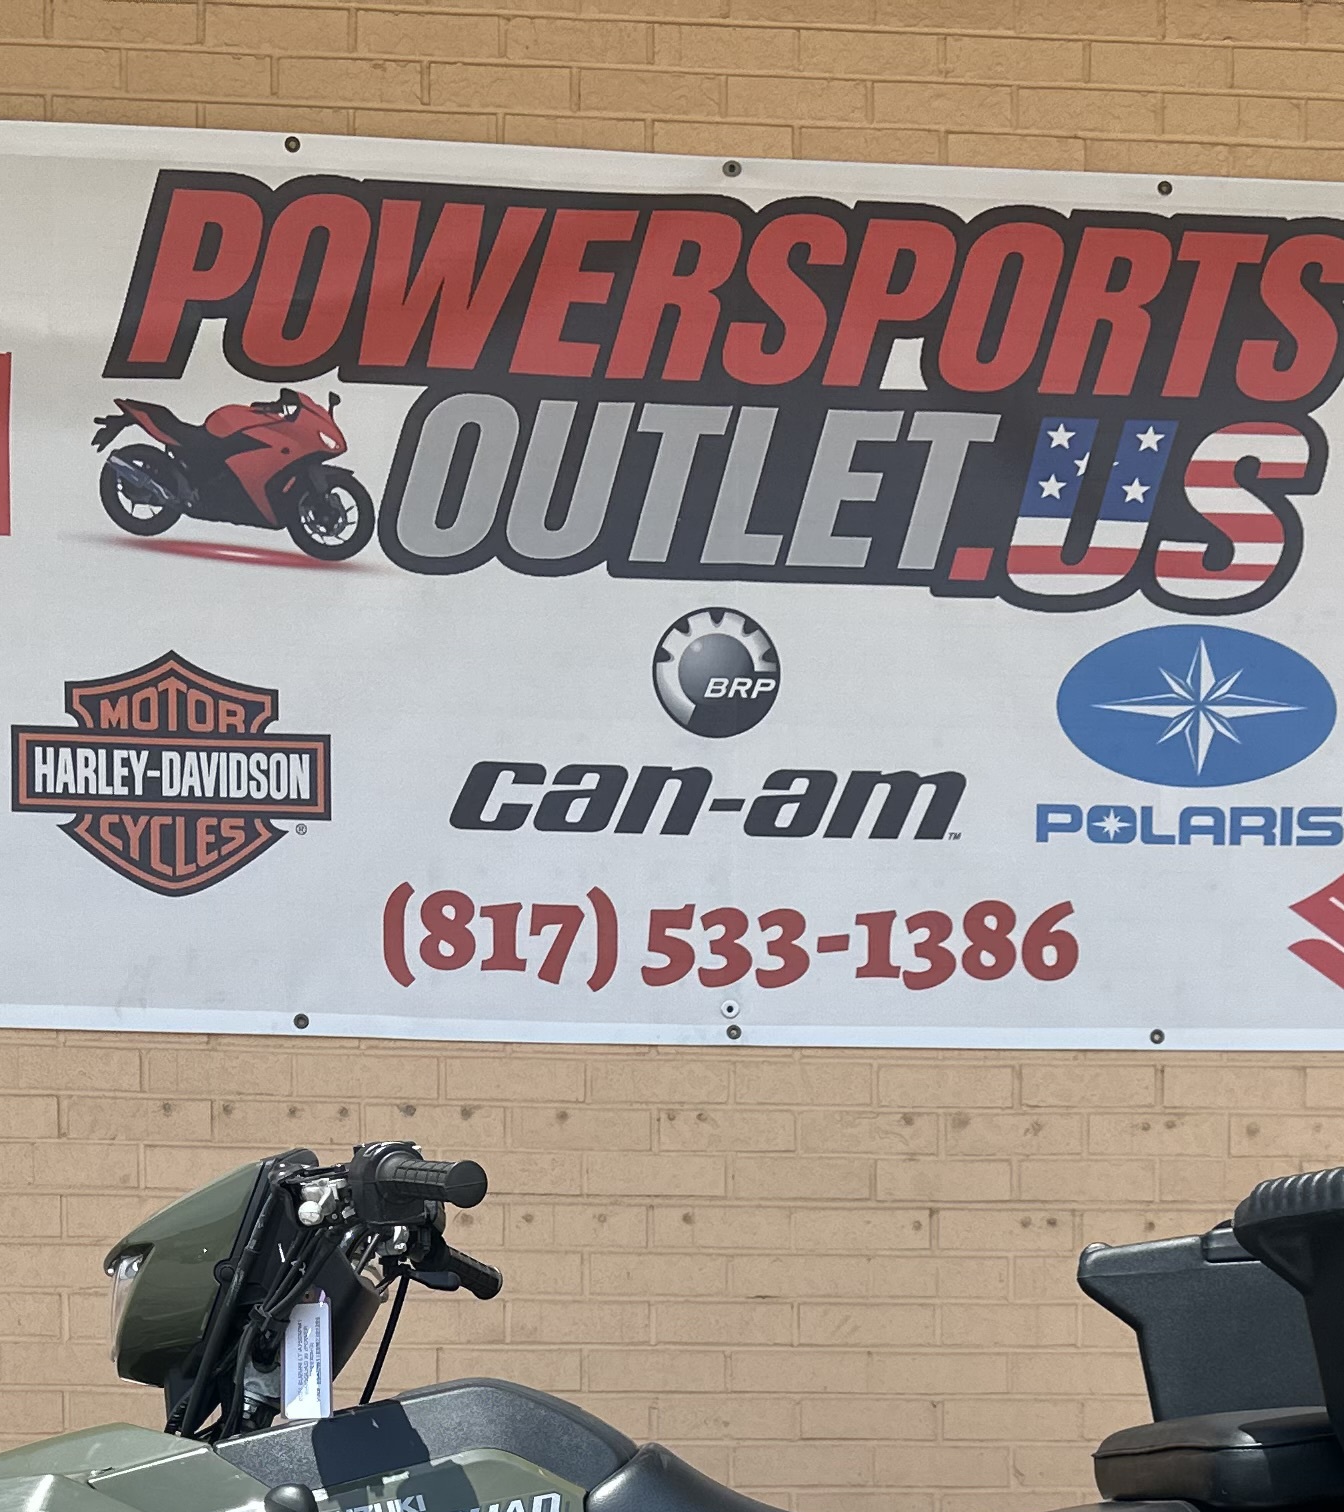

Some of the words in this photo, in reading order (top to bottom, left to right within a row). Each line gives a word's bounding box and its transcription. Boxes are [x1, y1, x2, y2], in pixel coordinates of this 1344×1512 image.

[395, 392, 1310, 600] OUTLET.US
[100, 676, 246, 733] MOTOR
[703, 676, 776, 699] BRP
[34, 746, 311, 800] HARLEY-DAVIDSON
[448, 760, 967, 840] can-am
[99, 813, 246, 877] CYCLES
[382, 882, 619, 992] (817)
[641, 900, 1080, 991] 533-1386
